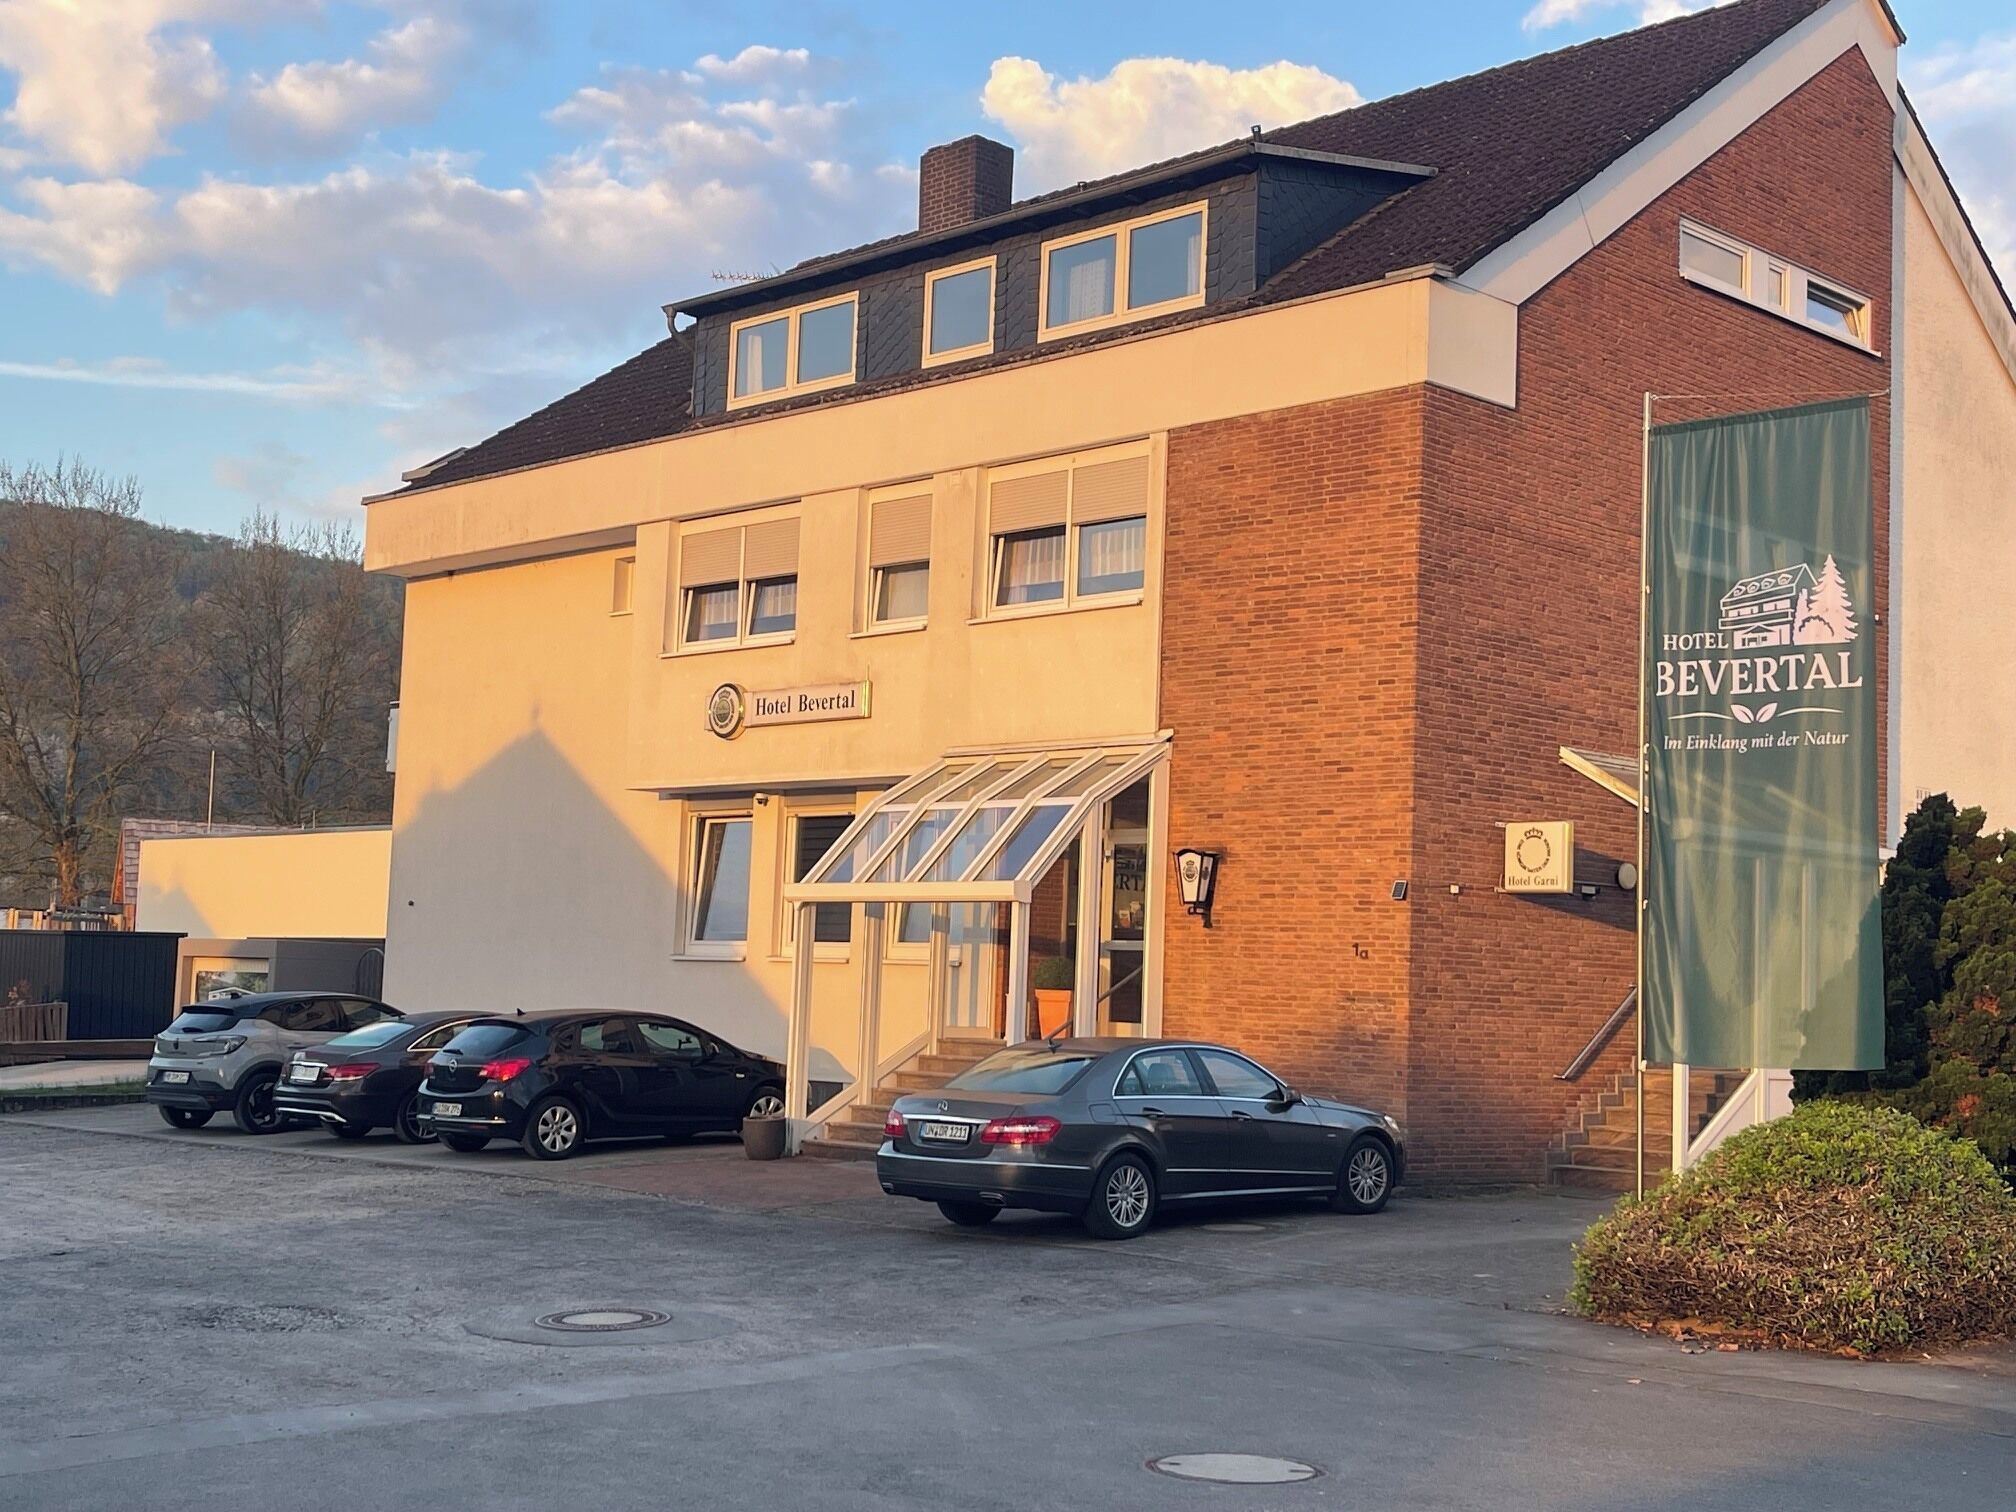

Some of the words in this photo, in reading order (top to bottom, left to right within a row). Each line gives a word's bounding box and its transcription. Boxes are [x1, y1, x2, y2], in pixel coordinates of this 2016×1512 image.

[1663, 633, 1728, 651] HOTEL
[1656, 652, 1863, 696] BEVERTAL
[756, 696, 791, 716] Hotel
[798, 689, 855, 712] Bevertal
[1664, 735, 1682, 750] Im
[1686, 734, 1748, 754] Einklang
[1751, 733, 1773, 748] mit
[1777, 731, 1800, 747] der
[1804, 730, 1849, 745] Natur
[1115, 873, 1145, 891] RT
[1508, 876, 1530, 886] Hotel
[1534, 875, 1558, 886] Garni
[1352, 942, 1369, 960] 1a
[949, 1126, 967, 1138] 1211
